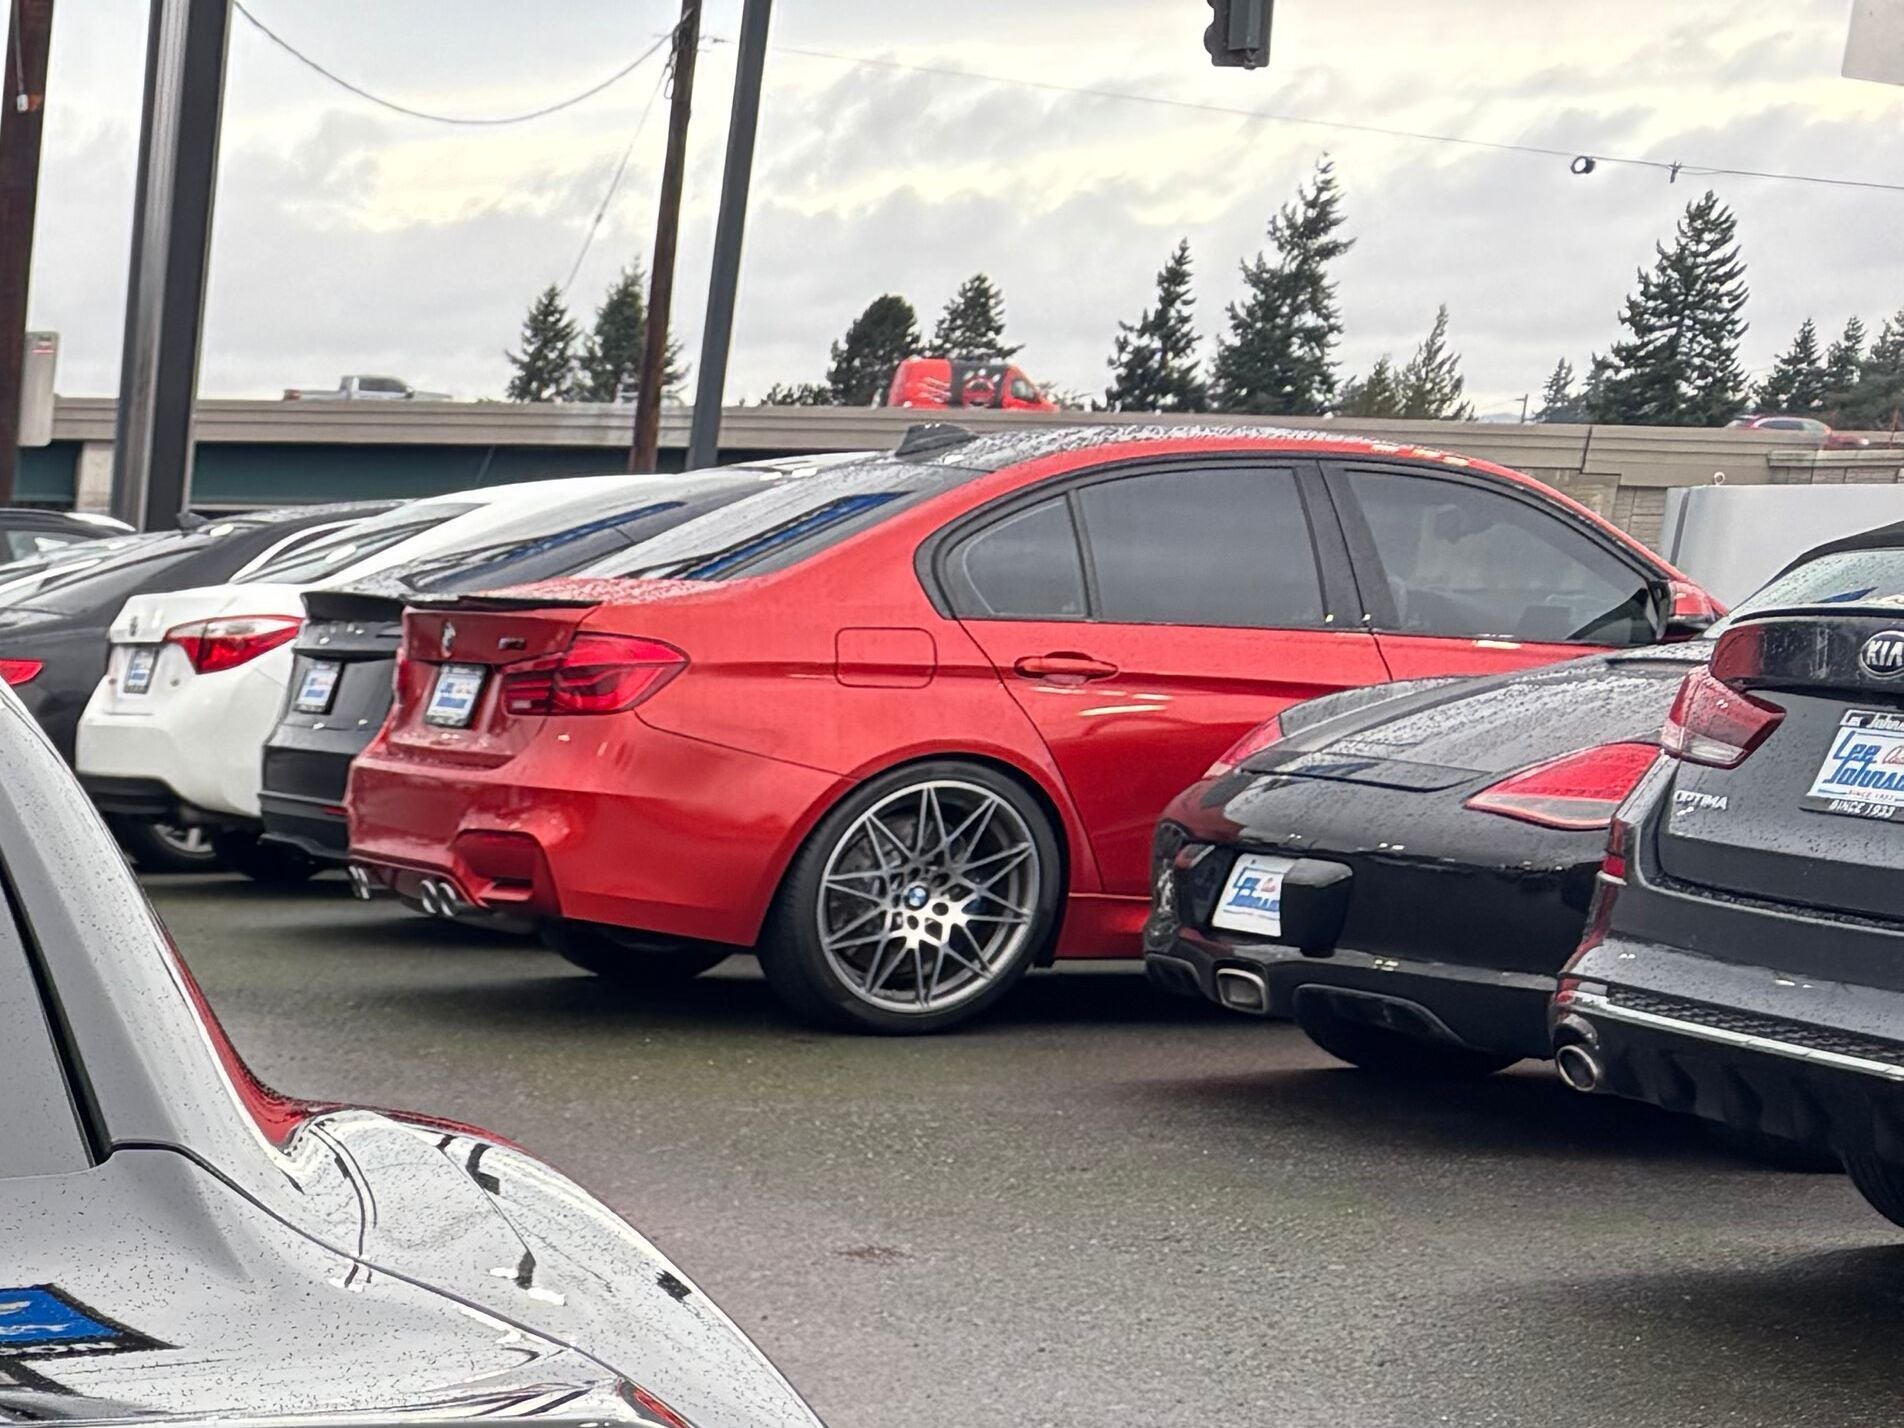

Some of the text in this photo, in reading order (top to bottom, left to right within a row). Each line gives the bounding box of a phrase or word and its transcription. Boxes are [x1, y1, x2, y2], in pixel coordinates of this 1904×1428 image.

[1866, 640, 1904, 667] KIA
[1832, 730, 1882, 763] Lee
[1674, 790, 1728, 811] OPTIMA
[1828, 799, 1897, 819] SINCE 1933
